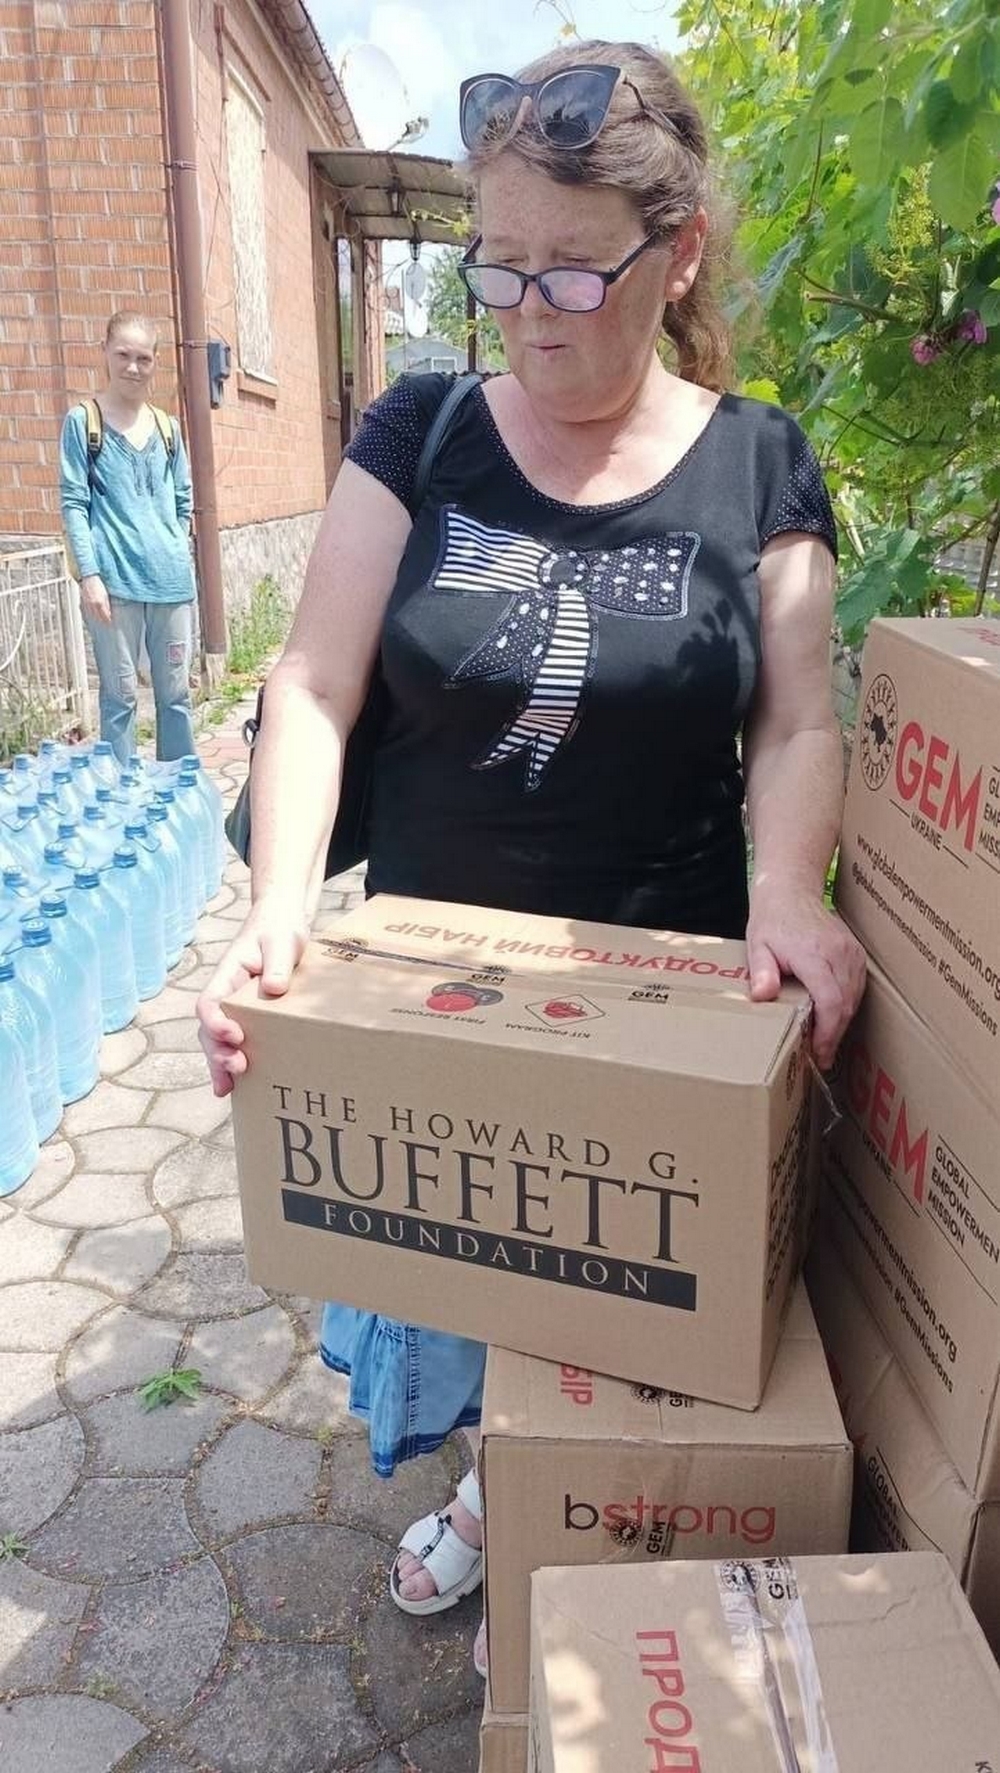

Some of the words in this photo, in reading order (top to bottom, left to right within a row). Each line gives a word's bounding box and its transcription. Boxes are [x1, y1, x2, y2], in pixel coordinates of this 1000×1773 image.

[895, 721, 983, 853] GEM
[910, 812, 942, 851] UKRAINE
[384, 922, 489, 947] НАБІР
[493, 937, 751, 981] РОДУКТОВИЙ
[631, 989, 669, 1000] GEM
[938, 957, 999, 1036] #GemMissions
[272, 1084, 358, 1124] THE
[389, 1106, 611, 1167] HOWARD
[649, 1151, 700, 1185] G.
[848, 1044, 929, 1207] GEM
[274, 1115, 700, 1264] BUFFETT
[935, 1146, 970, 1200] GLOBAL
[927, 1188, 966, 1248] MISSION
[323, 1203, 651, 1297] FOUNDATION
[893, 1287, 955, 1394] #GemMissions
[564, 1494, 776, 1544] bstrong
[646, 1520, 666, 1554] GEM
